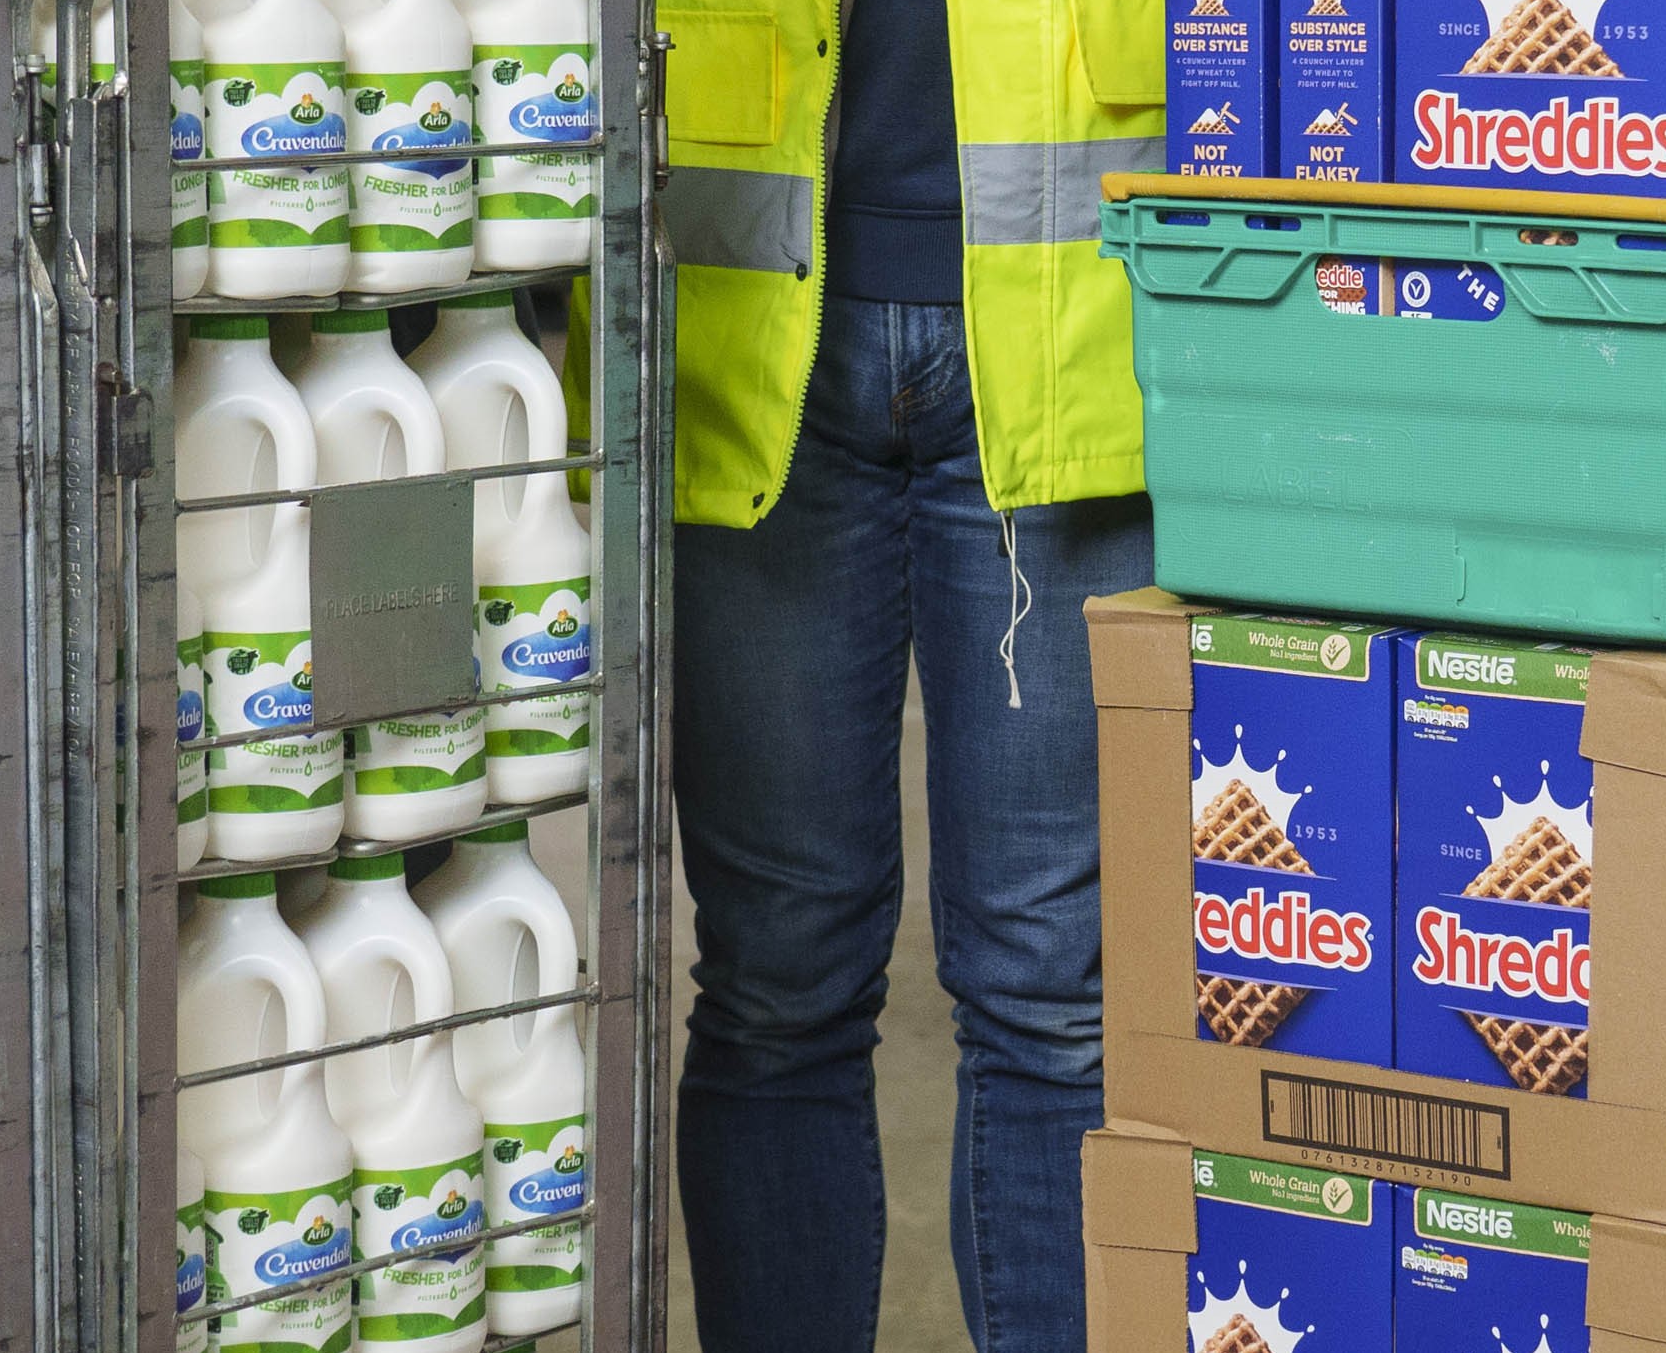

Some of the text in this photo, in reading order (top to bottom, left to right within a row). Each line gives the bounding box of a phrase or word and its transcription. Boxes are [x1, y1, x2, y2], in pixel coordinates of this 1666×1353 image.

[1174, 23, 1247, 35] SUBSTANCE
[1290, 23, 1366, 35] SUBSTANCE
[1438, 23, 1649, 39] SINCE 1953
[1173, 40, 1249, 52] OVER STYLE
[1289, 40, 1367, 52] OVER STYLE
[559, 85, 581, 98] Arla
[295, 106, 320, 119] Arla
[424, 114, 448, 127] Arla
[251, 127, 345, 151] Cravendale
[1194, 145, 1228, 160] NOT
[1310, 147, 1345, 162] NOT
[233, 170, 319, 192] FRESHER FOR
[1296, 166, 1360, 182] FLAKEY
[364, 174, 447, 198] FRESHER FOR
[1317, 265, 1364, 288] eddie
[1319, 290, 1337, 299] FOR
[552, 621, 575, 633] Arla
[1247, 632, 1320, 652] Whole Grain
[1428, 649, 1515, 686] Nestlé
[378, 722, 460, 738] FRESHER FOR
[302, 745, 318, 755] FOR
[1294, 824, 1338, 842] 1953
[1440, 843, 1483, 861] SINCE
[559, 1157, 581, 1170] Arla
[1249, 1170, 1321, 1194] Whole Grain
[441, 1200, 464, 1215] Arla
[1426, 1199, 1514, 1239] Nestlé
[307, 1228, 330, 1241] Arla
[265, 1242, 350, 1276] Cravendale
[383, 1267, 462, 1285] FRESHER FOR
